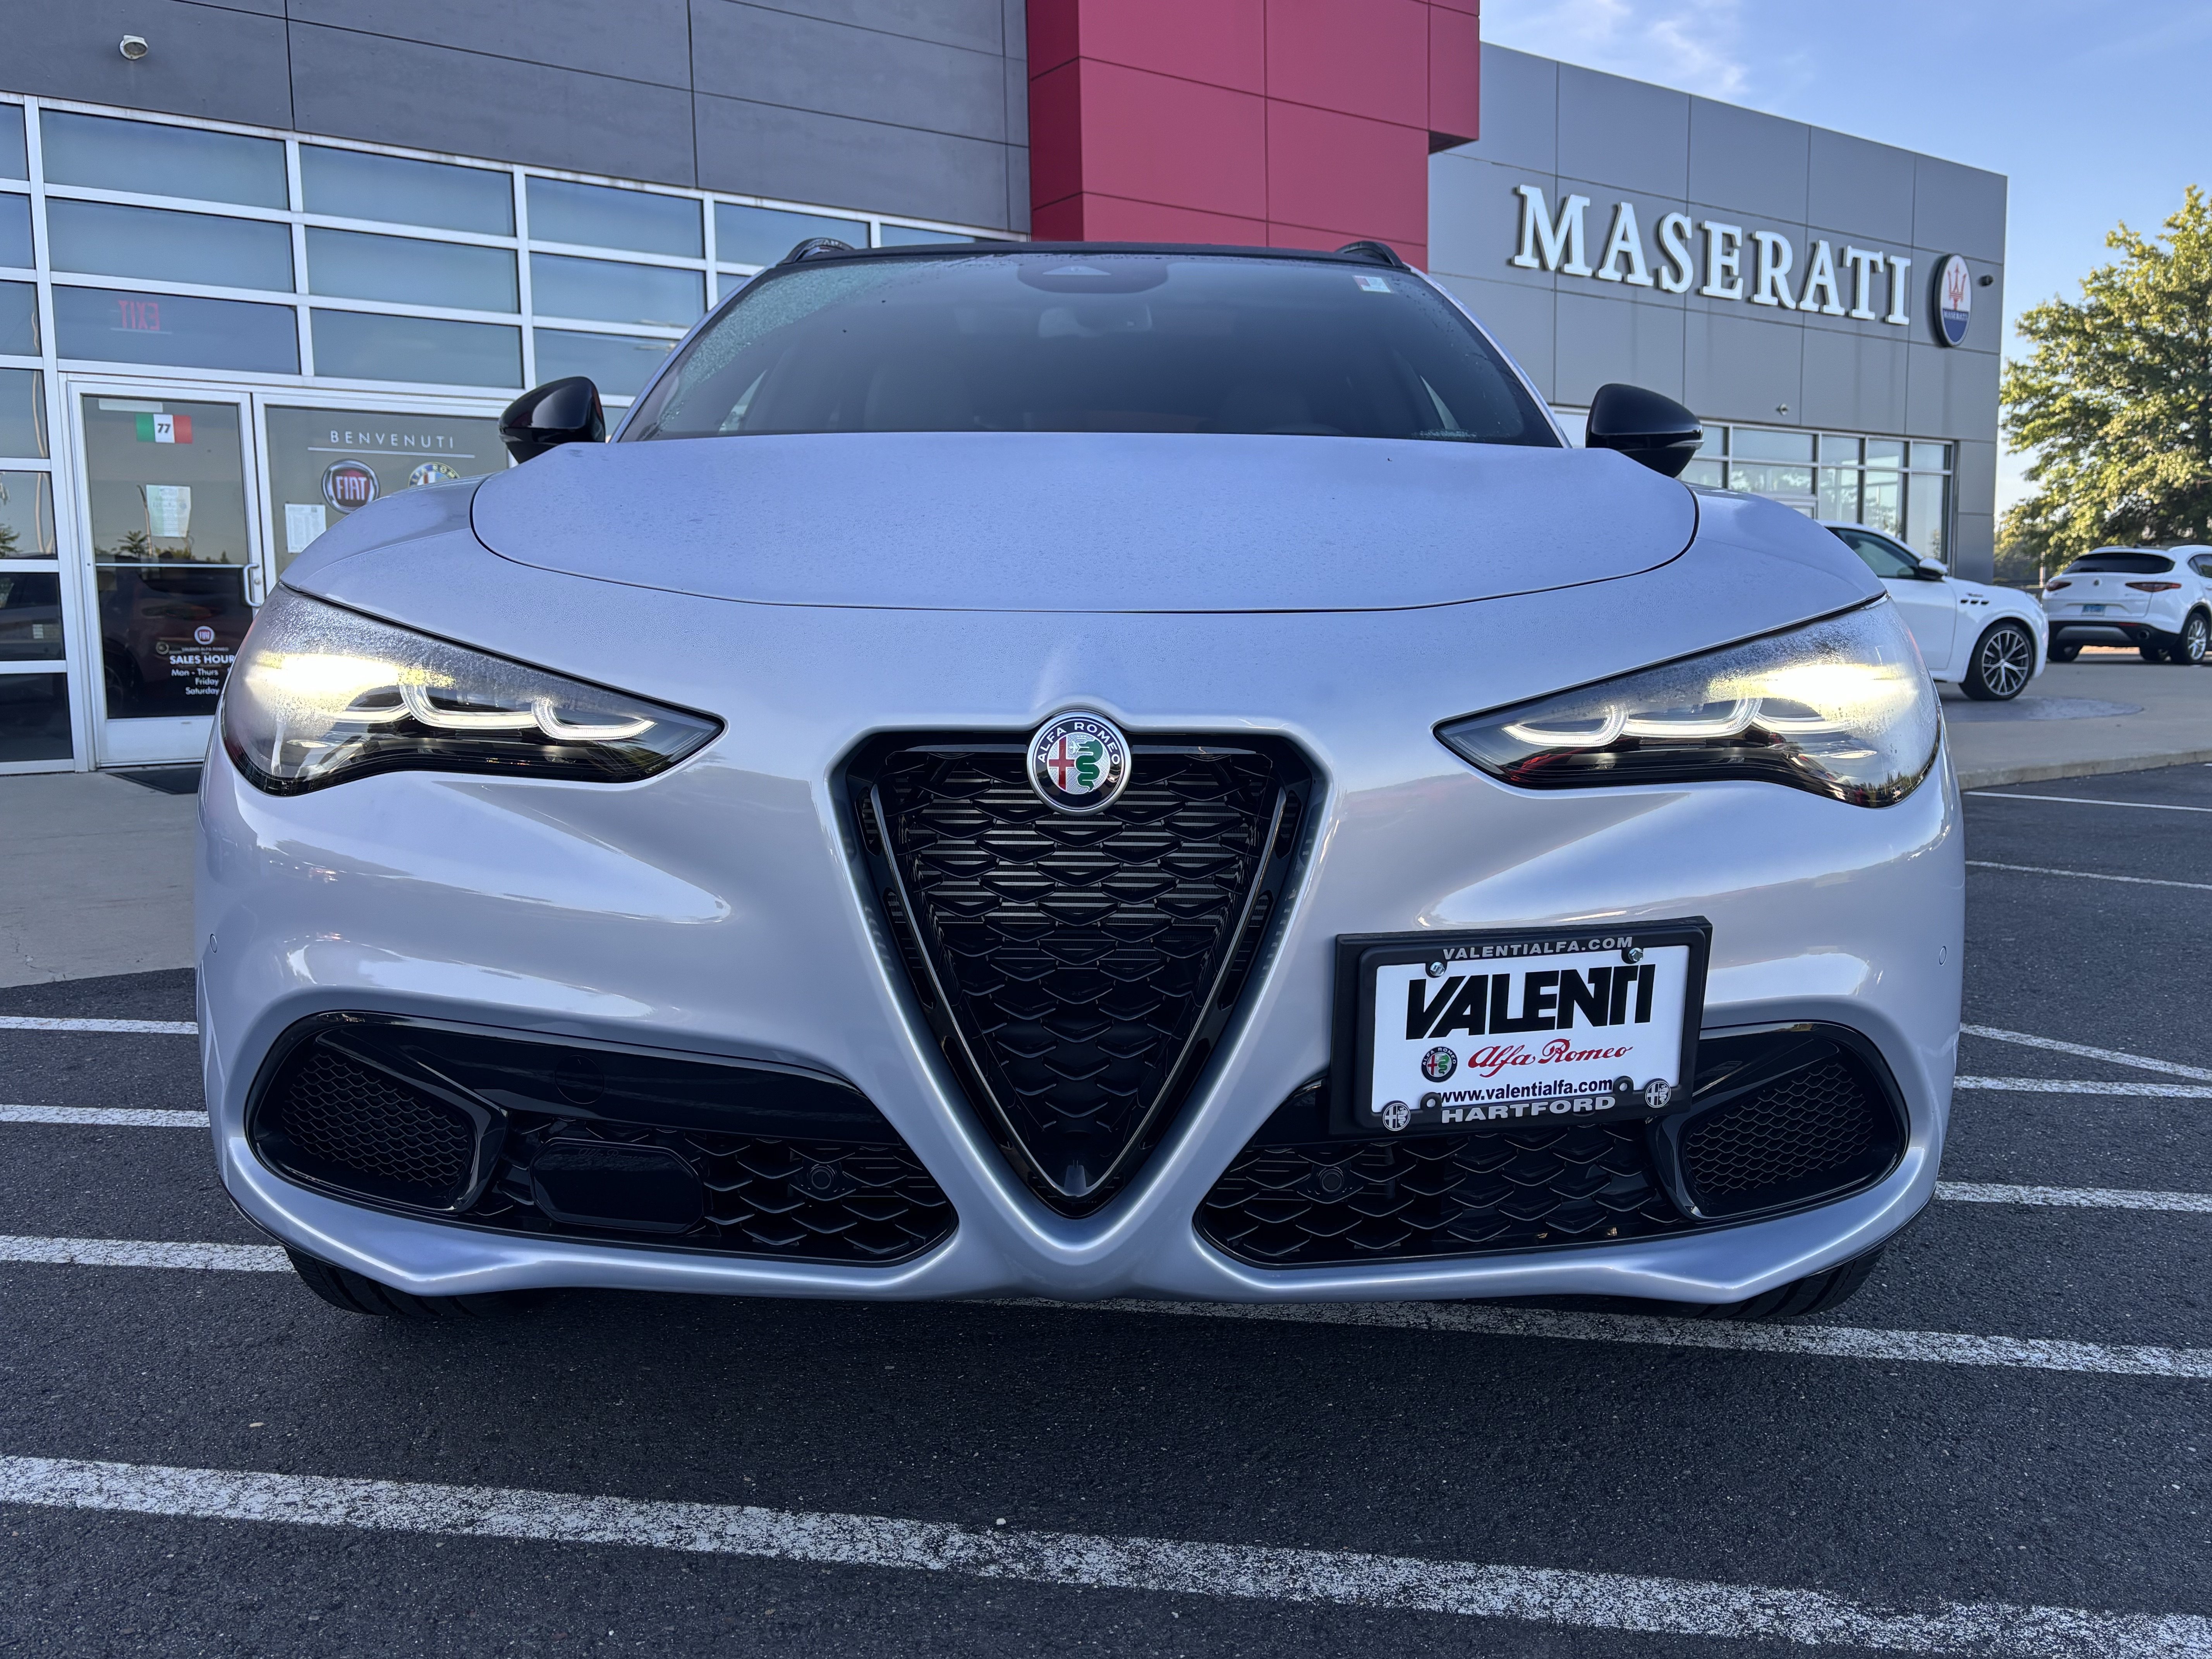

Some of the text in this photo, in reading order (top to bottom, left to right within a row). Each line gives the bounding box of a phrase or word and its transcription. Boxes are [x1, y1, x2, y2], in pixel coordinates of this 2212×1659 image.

[1511, 184, 1911, 326] MASERATI
[157, 423, 171, 433] 77
[330, 430, 453, 449] BENVENUTI
[335, 476, 368, 501] FIAT
[170, 655, 236, 665] SALES HOUR
[196, 668, 219, 676] Thurs
[185, 687, 220, 696] Saturday
[195, 677, 220, 686] Friday
[1037, 721, 1120, 765] ALFA ROMEO
[1443, 936, 1633, 960] VALENTIALFA.COM
[1405, 963, 1656, 1040] VALENTI
[1422, 1047, 1456, 1066] ALFA ROMEO
[1468, 1038, 1633, 1078] Alfa Romeo
[1437, 1079, 1613, 1103] www.valentialfa.com
[1441, 1096, 1616, 1123] HARTFORD
